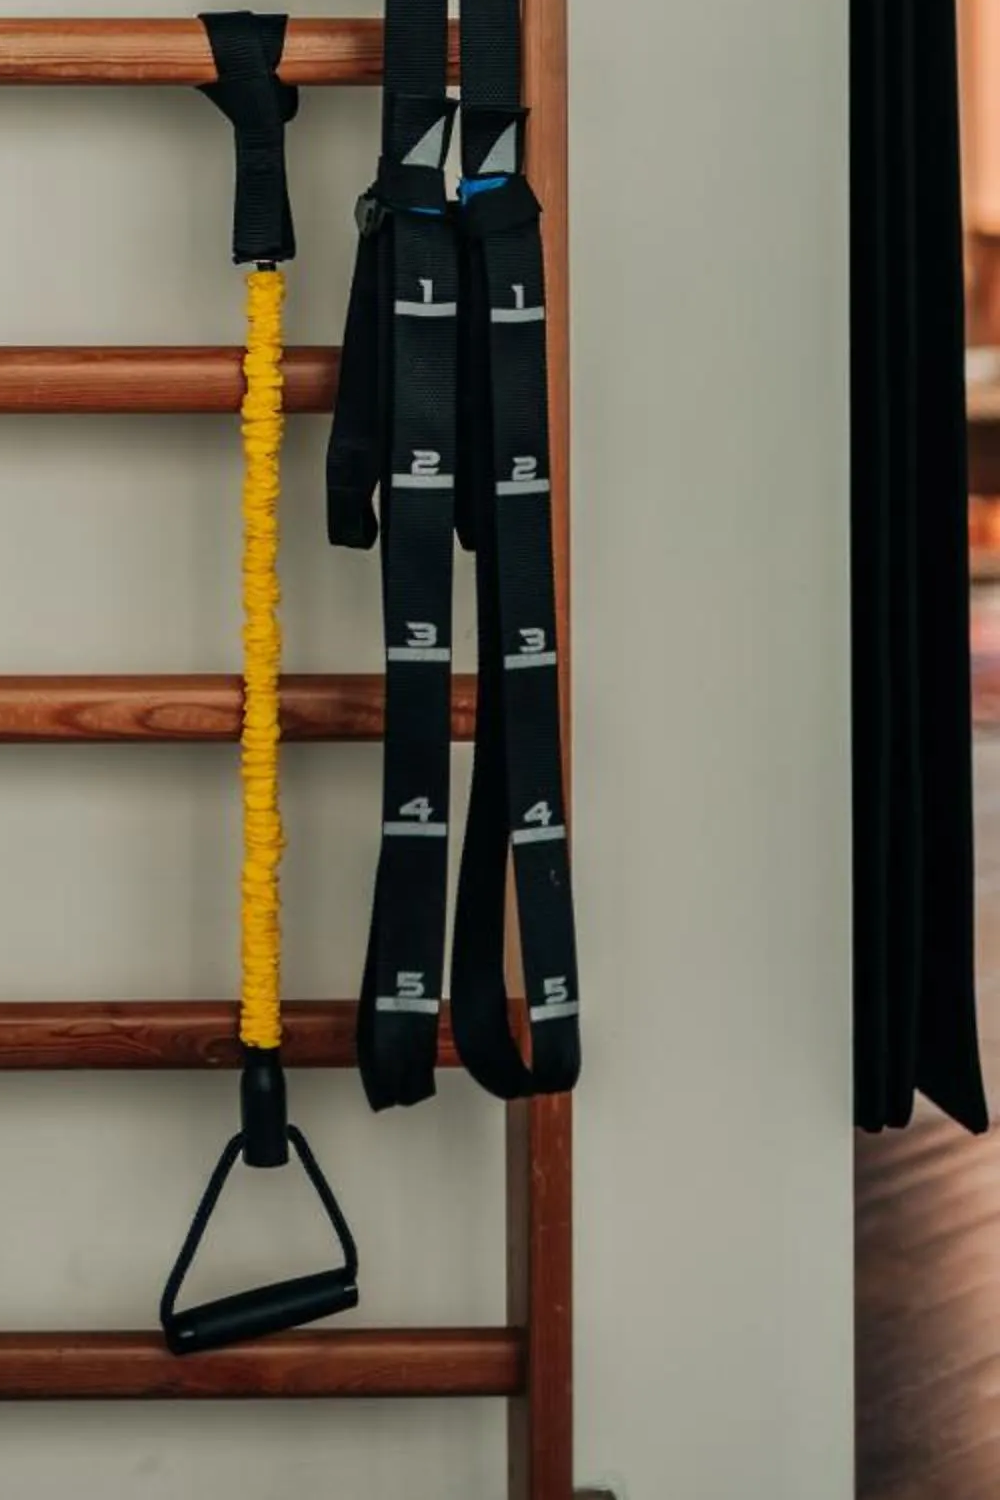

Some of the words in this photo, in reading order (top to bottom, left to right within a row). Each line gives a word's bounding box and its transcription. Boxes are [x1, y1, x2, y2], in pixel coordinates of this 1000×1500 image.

[418, 278, 434, 303] 1
[511, 283, 526, 309] 1
[411, 450, 442, 476] 2
[511, 455, 538, 481] 2
[405, 621, 438, 648] 3
[518, 627, 546, 654] 3
[398, 796, 434, 823] 4
[522, 800, 553, 826] 4
[395, 971, 426, 999] 5
[542, 976, 568, 1005] 5
